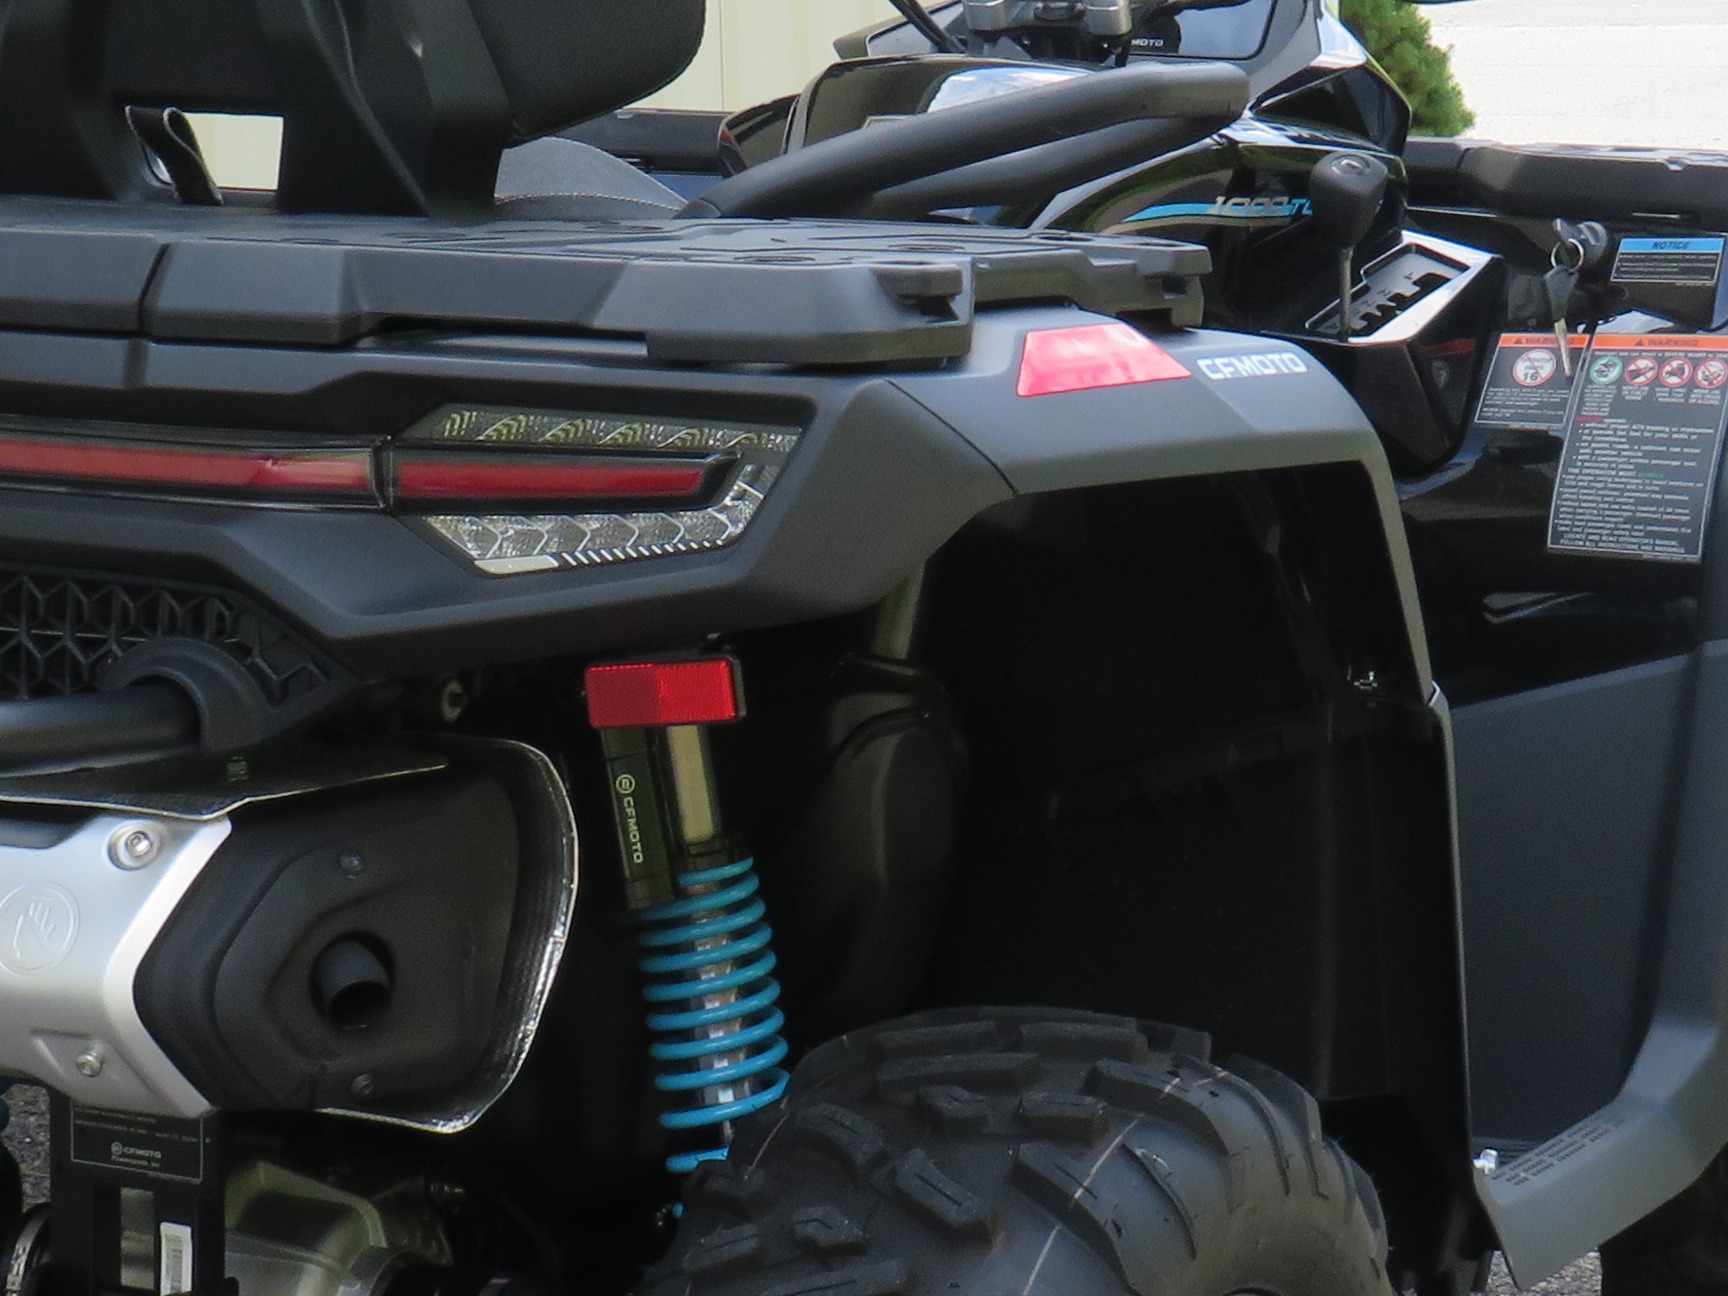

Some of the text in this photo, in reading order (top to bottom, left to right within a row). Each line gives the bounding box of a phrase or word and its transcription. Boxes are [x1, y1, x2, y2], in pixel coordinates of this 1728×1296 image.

[1650, 241, 1690, 250] NOTICE
[1648, 339, 1699, 347] WARNING
[1196, 352, 1309, 381] CFMOTO
[1522, 371, 1539, 382] 16
[622, 796, 644, 864] CFMOTO
